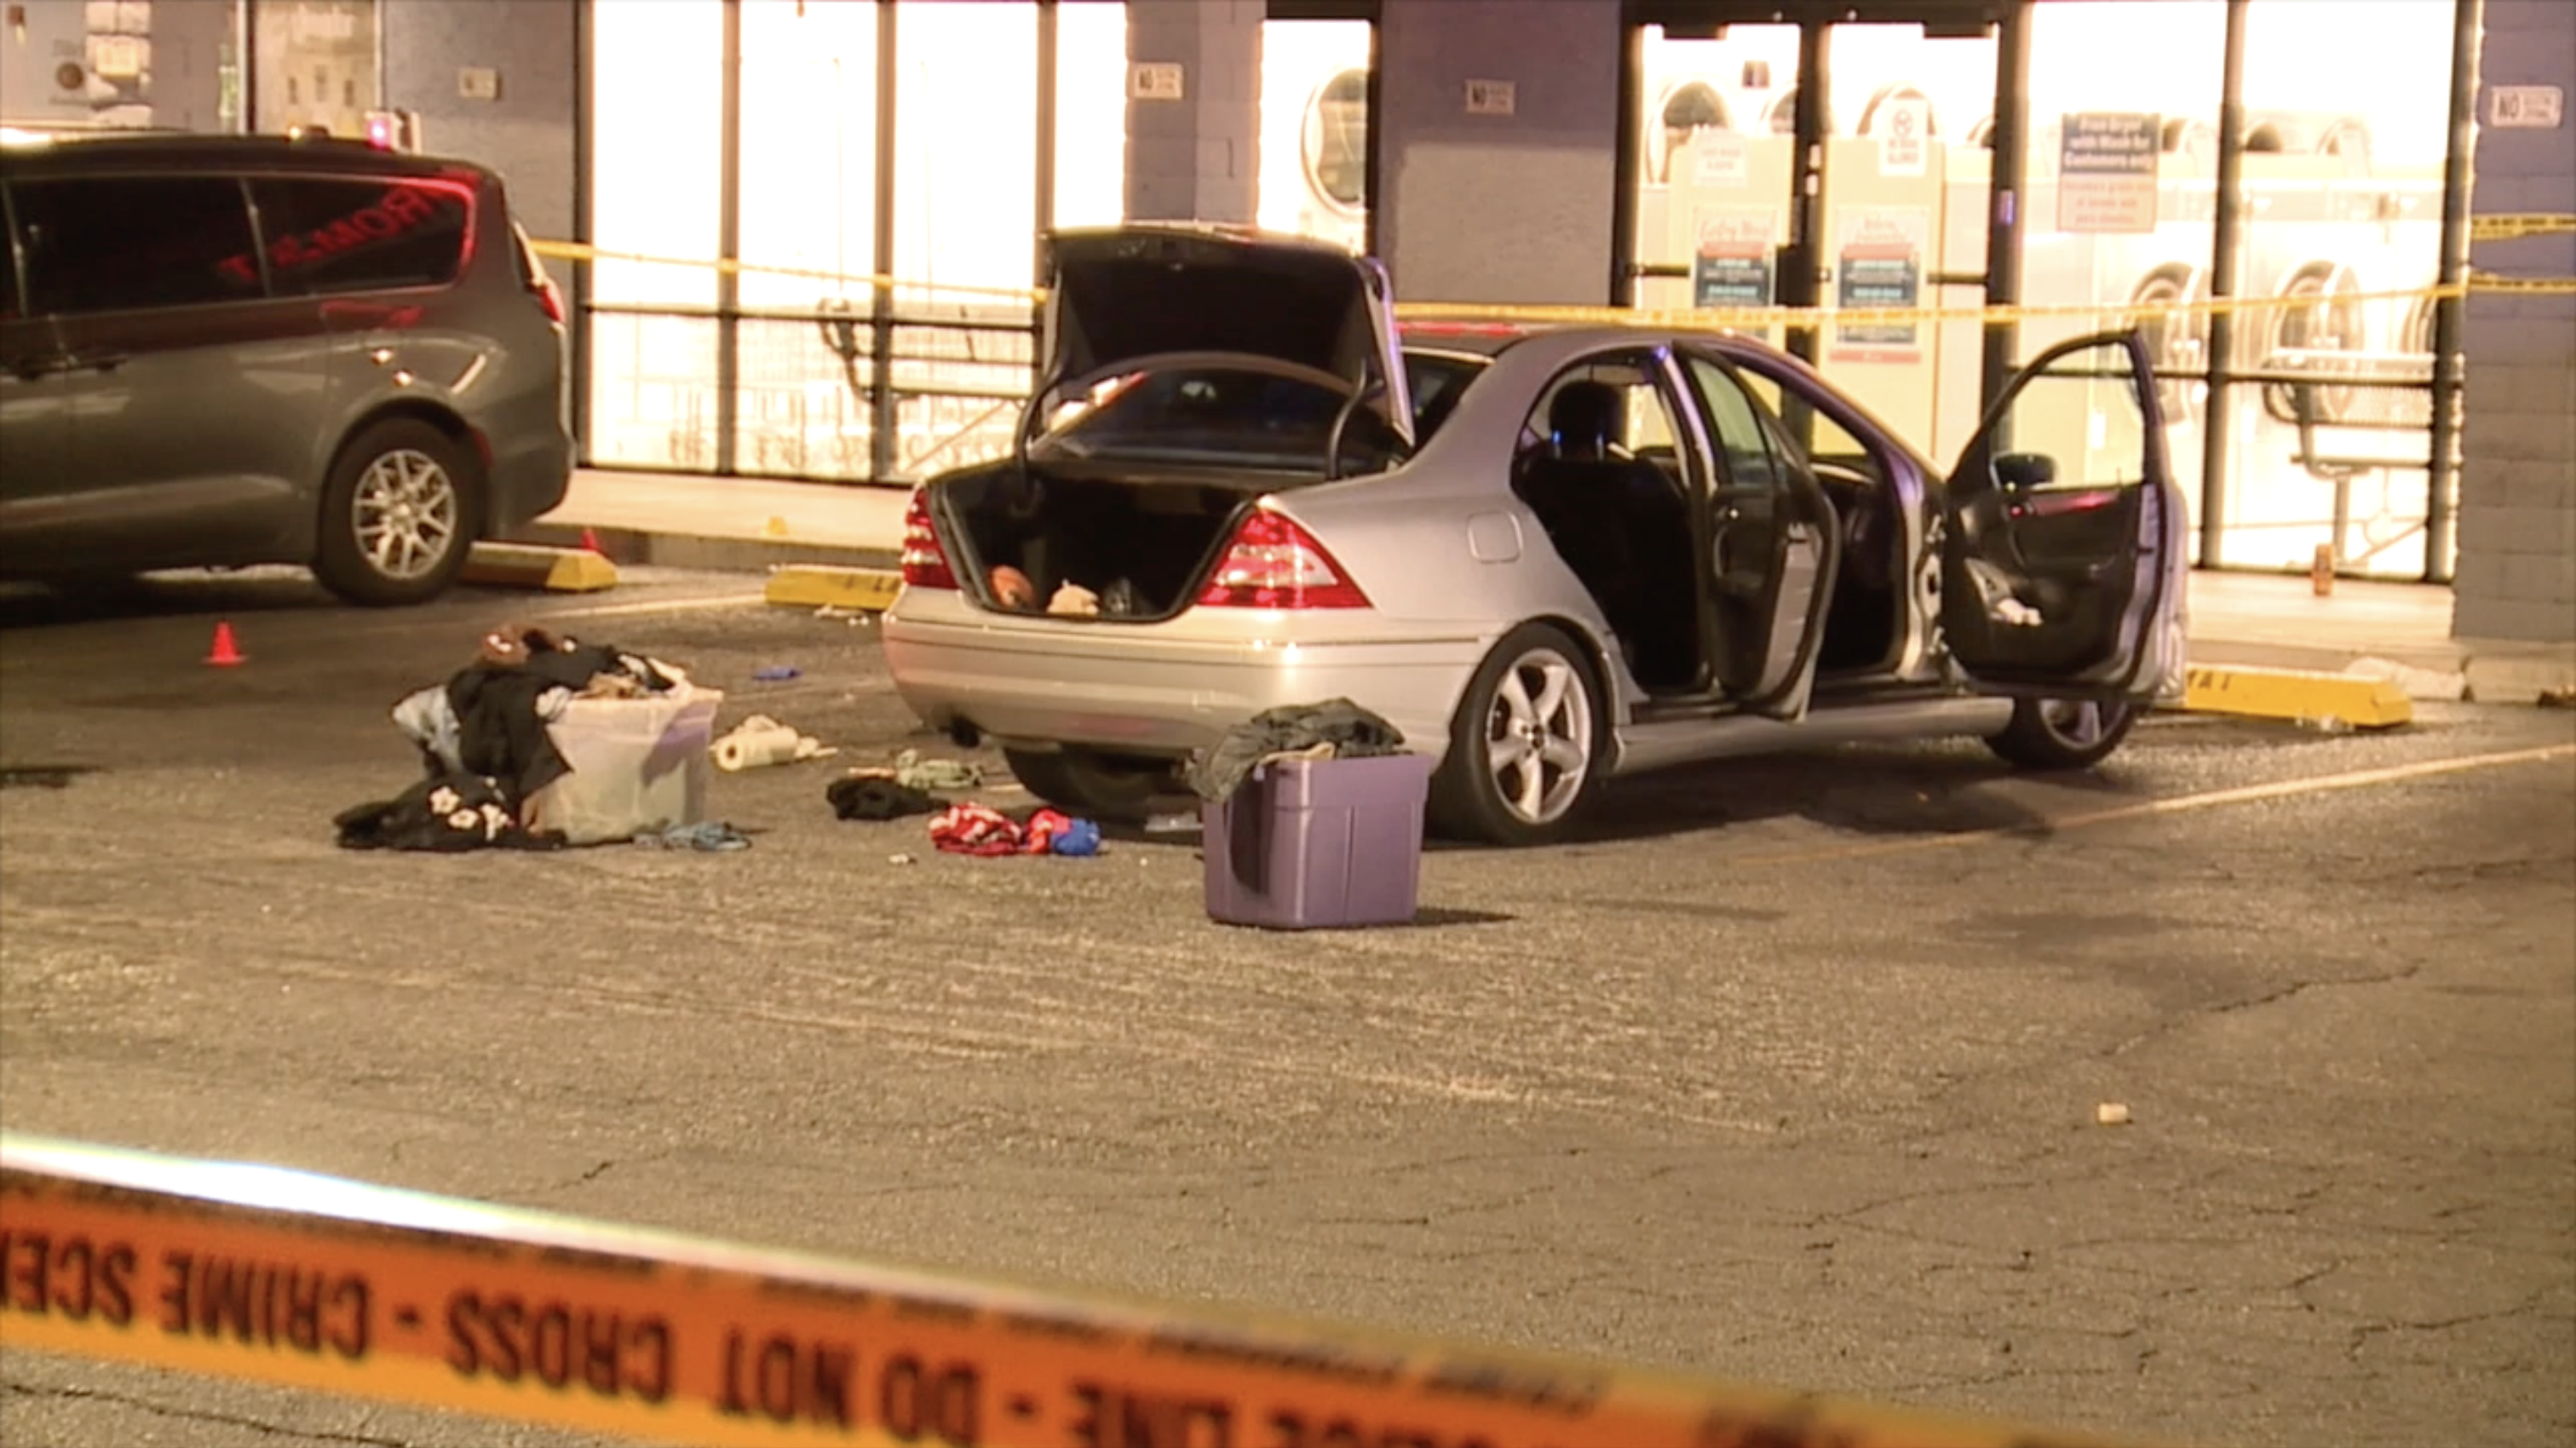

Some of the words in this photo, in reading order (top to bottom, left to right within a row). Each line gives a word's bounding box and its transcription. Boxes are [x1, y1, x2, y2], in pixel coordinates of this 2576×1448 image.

[2498, 91, 2519, 120] NO
[0, 1227, 136, 1325] SCE
[159, 1249, 371, 1359] CRIME
[446, 1289, 672, 1404] CROSS
[716, 1329, 854, 1431] NOT
[879, 1351, 981, 1446] DO
